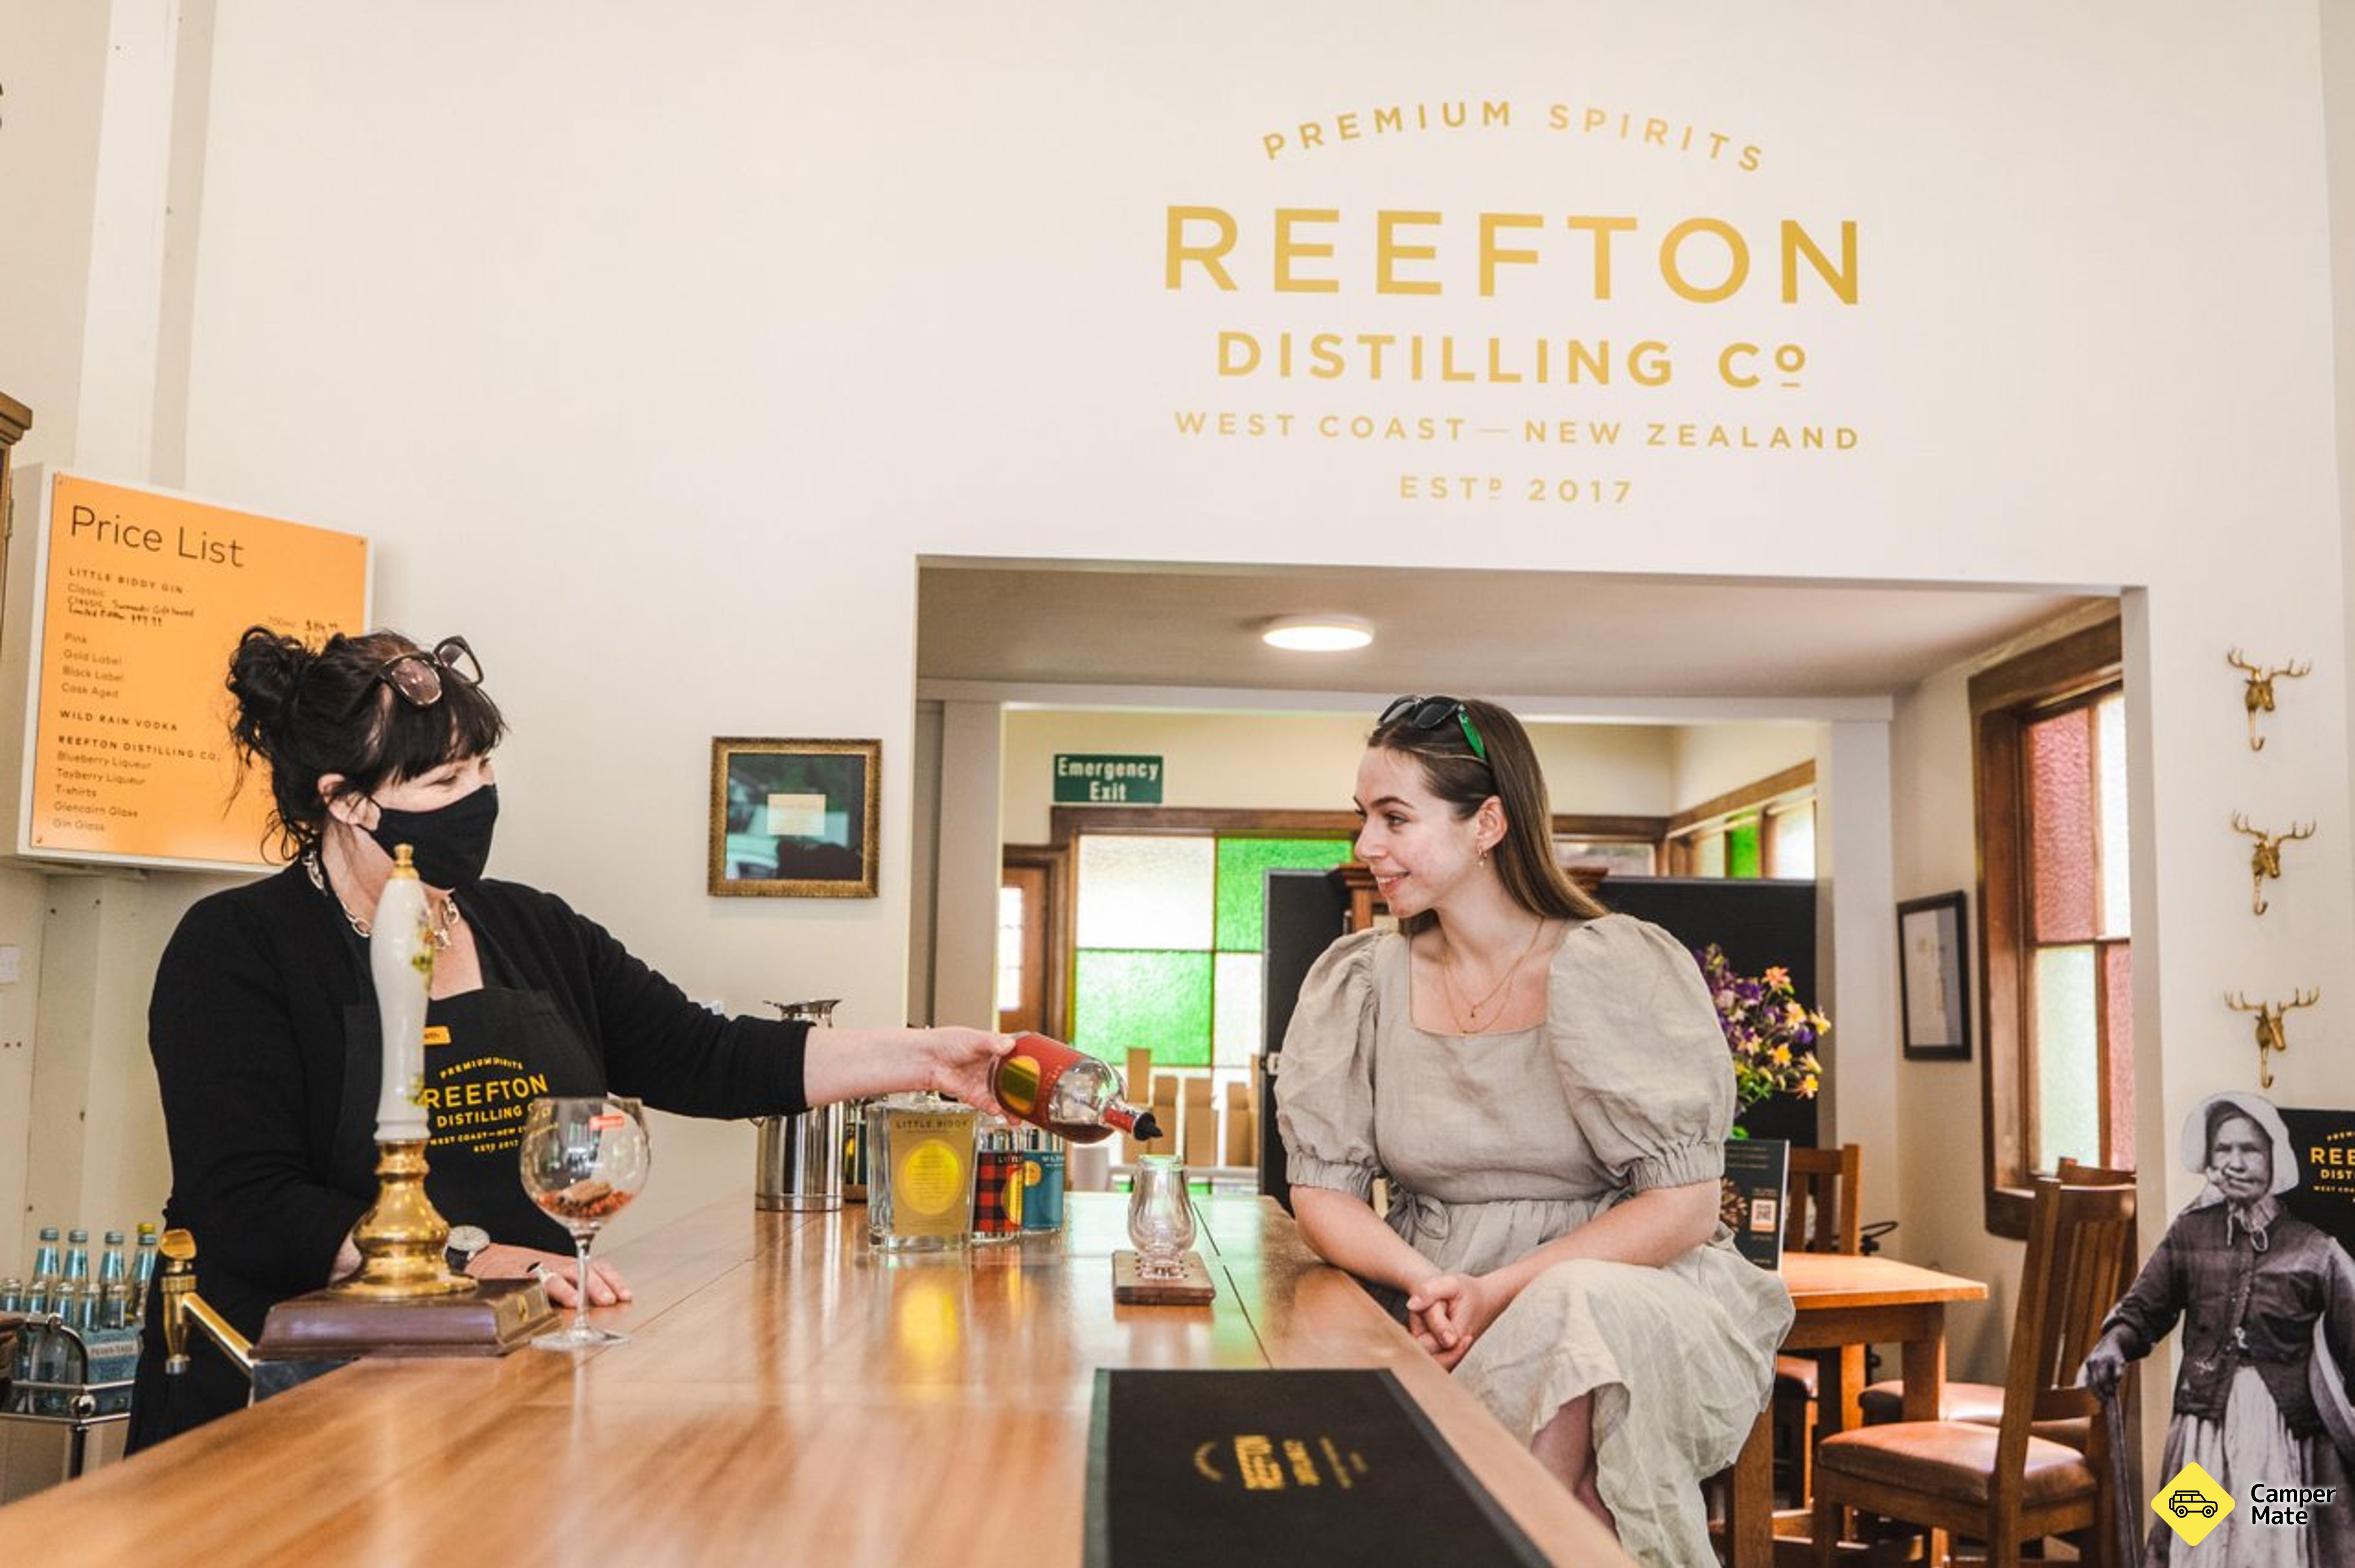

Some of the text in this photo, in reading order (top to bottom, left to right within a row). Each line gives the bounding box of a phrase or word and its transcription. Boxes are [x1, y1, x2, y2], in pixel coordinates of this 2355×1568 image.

[1262, 101, 1762, 172] PREMIUM SPIRITS
[1165, 205, 1859, 306] REEFTON
[1217, 331, 1672, 387] DISTILLING
[1174, 411, 1295, 437] WEST
[1647, 423, 1858, 450] ZEALAND
[1528, 479, 1632, 504] 2017
[70, 504, 245, 567] Price List
[68, 566, 111, 582] LITTLE
[63, 648, 122, 666] Gold Label
[62, 665, 91, 678] Black
[59, 710, 177, 731] WILD RAIN VODKA
[57, 750, 110, 766] Blueberry
[58, 735, 117, 749] REEFTON
[123, 742, 194, 758] DISTILLING
[1058, 757, 1159, 781] Emergency
[1090, 780, 1126, 801] Exit
[108, 806, 138, 818] Glass
[423, 1074, 549, 1109] REEFTON
[436, 1105, 523, 1128] DISTILLING
[896, 1119, 931, 1128] LITTLE
